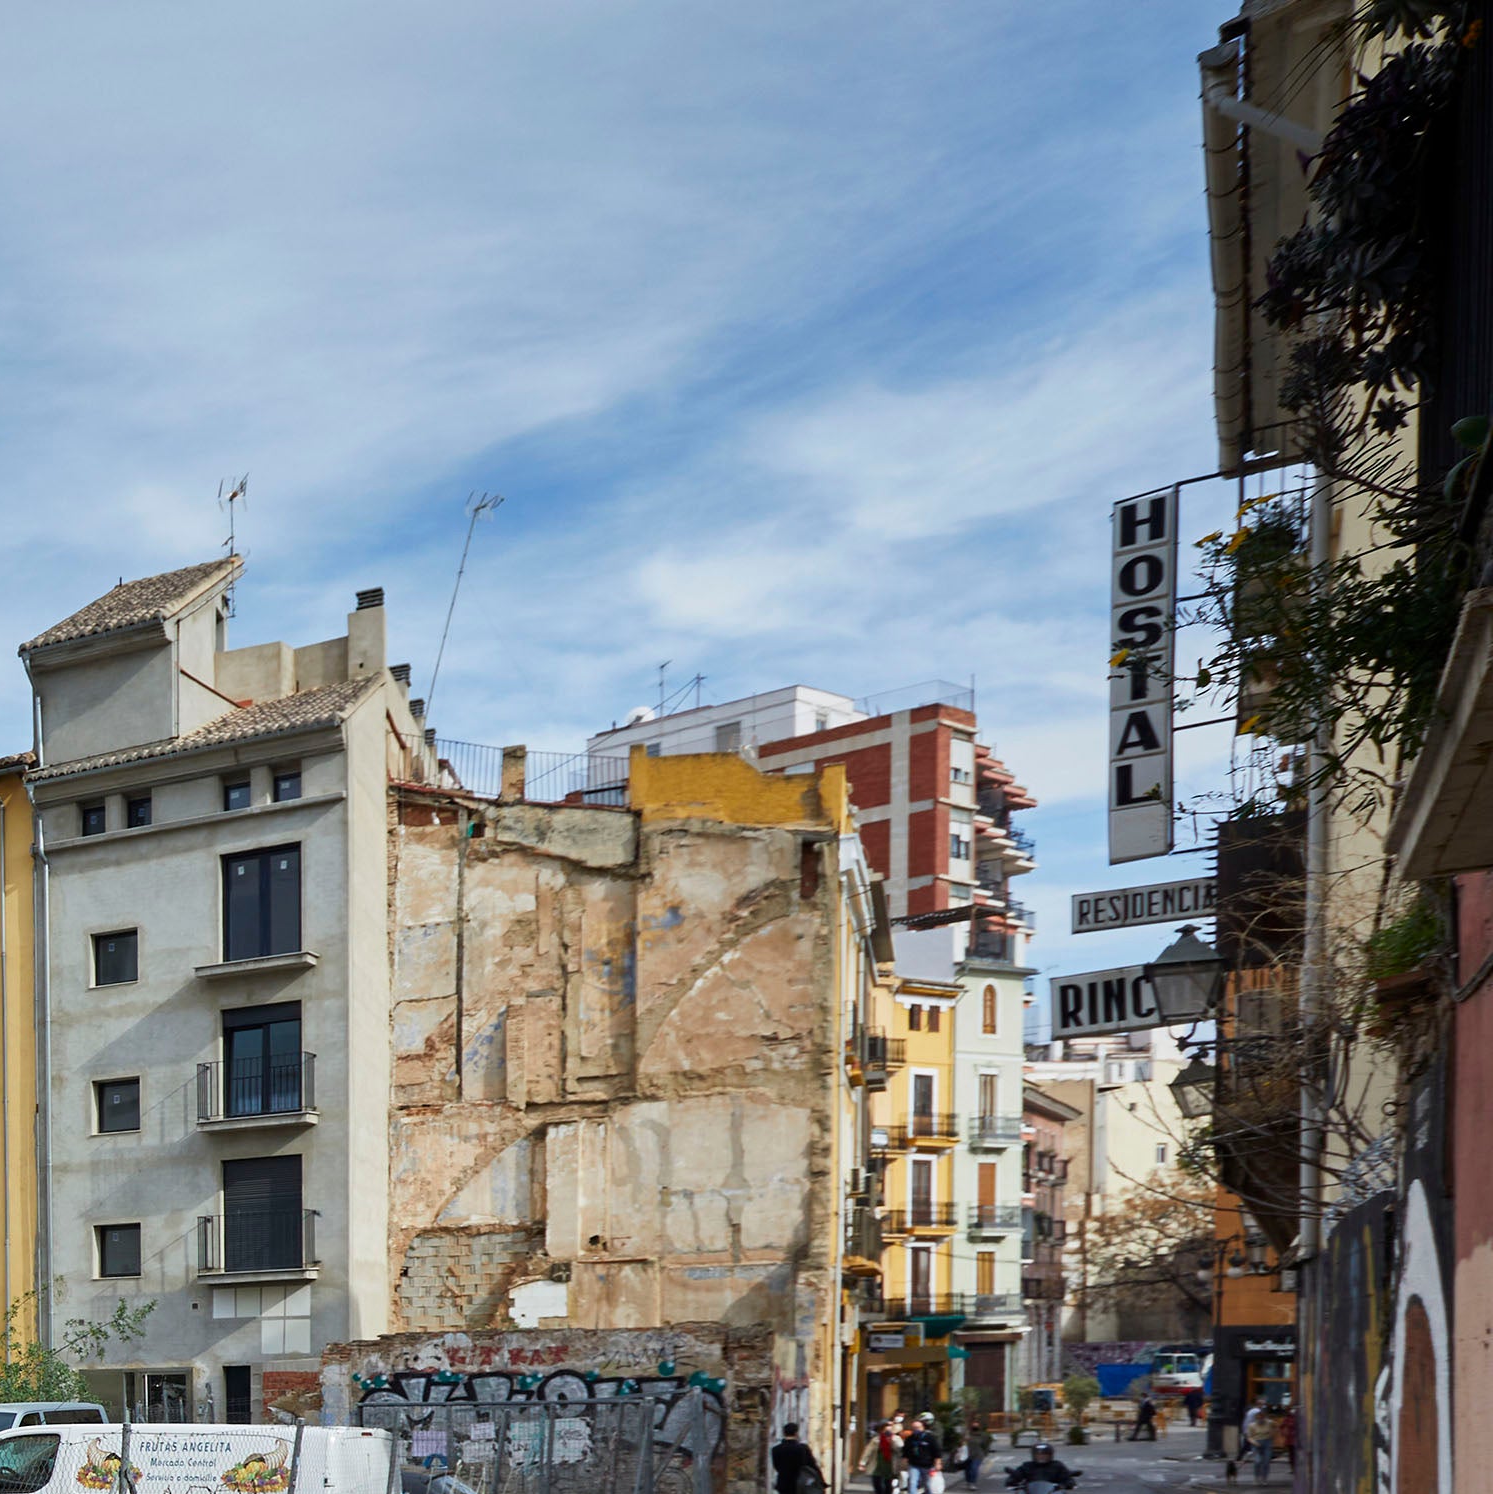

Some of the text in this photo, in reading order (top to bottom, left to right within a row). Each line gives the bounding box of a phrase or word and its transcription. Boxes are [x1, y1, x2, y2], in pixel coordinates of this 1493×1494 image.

[1115, 496, 1167, 808] HOSTAL
[140, 1441, 232, 1452] FRUTAS ANGELITA
[150, 1458, 217, 1467] Mercado Central
